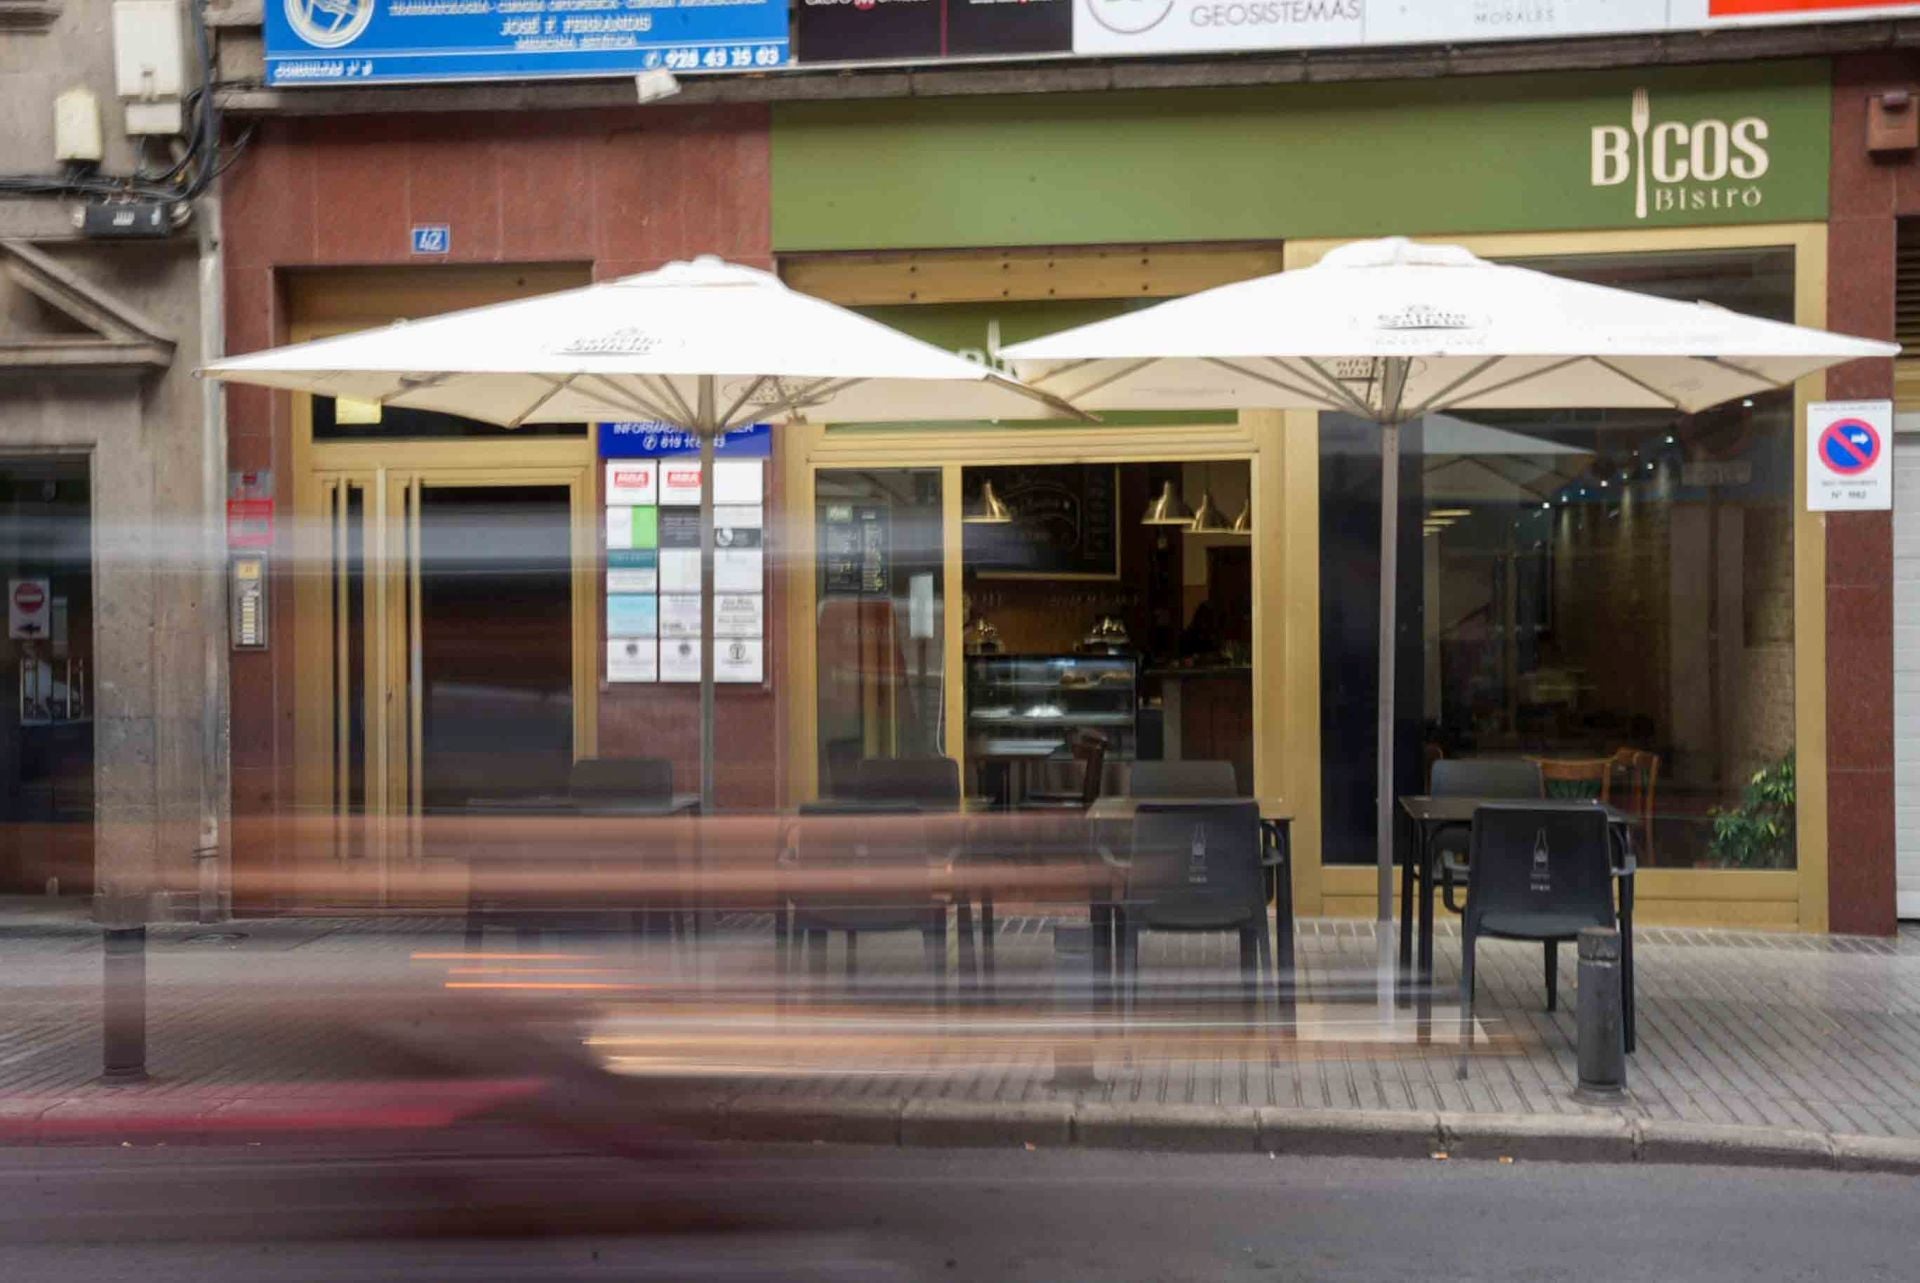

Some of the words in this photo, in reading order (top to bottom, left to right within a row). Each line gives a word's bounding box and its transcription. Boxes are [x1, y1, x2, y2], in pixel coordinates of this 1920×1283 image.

[1190, 1, 1361, 27] GEOSISTEMAS
[1474, 9, 1555, 25] MORALES
[665, 48, 699, 68] 928
[703, 47, 727, 67] 43
[731, 47, 752, 66] 15
[1591, 88, 1769, 216] BICOS
